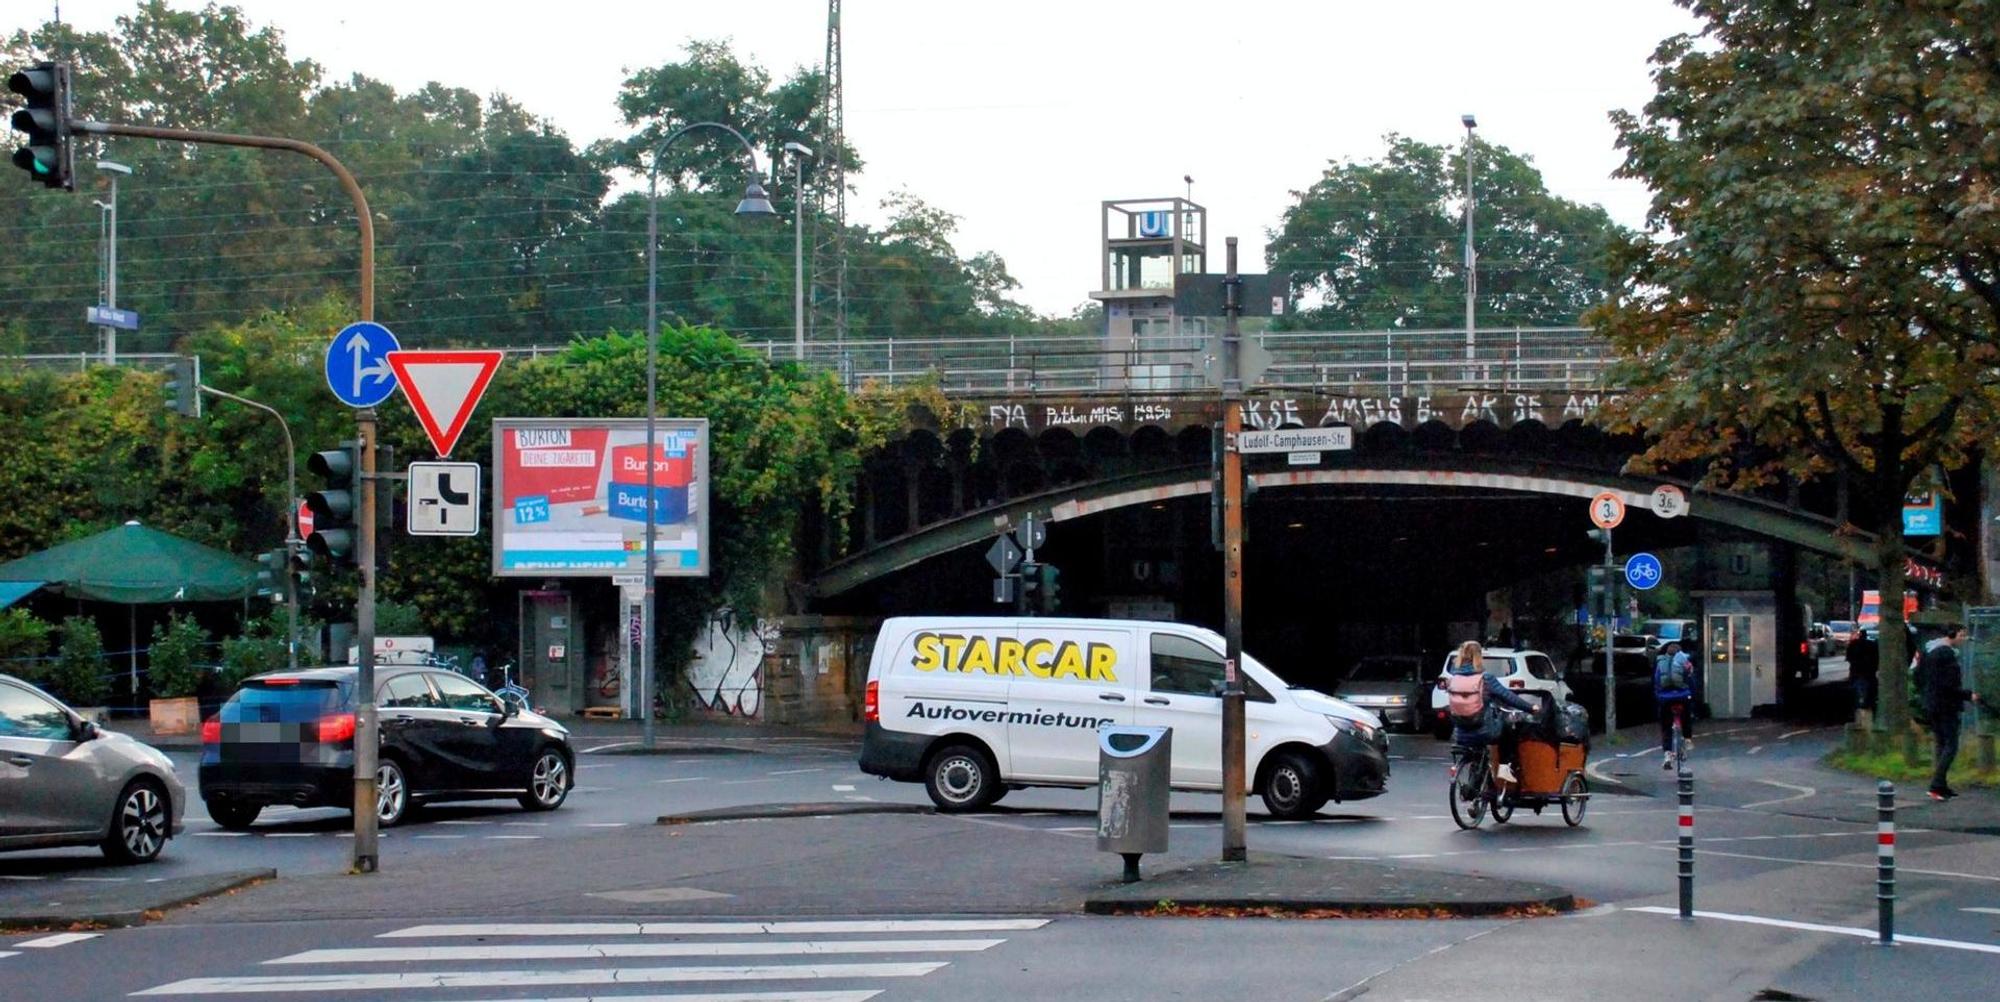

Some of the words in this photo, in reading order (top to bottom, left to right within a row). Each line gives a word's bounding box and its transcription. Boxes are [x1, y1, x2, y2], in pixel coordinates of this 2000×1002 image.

[520, 430, 567, 447] BURTON
[1243, 432, 1346, 450] Ludolf-Camphausen-Str.
[624, 456, 669, 472] Buron
[911, 631, 1118, 682] STARCAR
